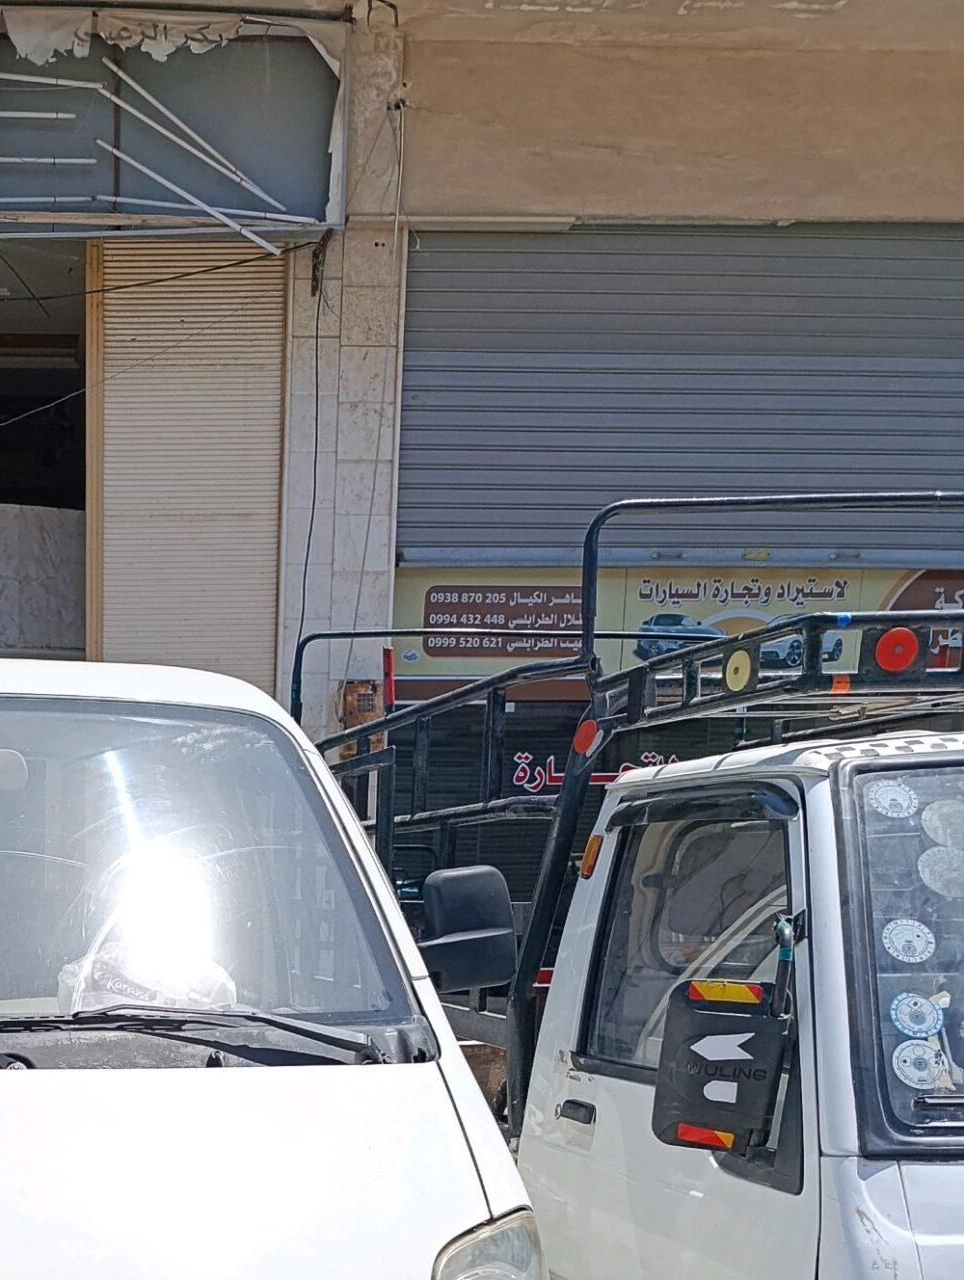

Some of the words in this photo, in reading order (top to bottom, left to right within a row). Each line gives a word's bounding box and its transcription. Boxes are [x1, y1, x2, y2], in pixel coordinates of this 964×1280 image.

[430, 592, 459, 604] 0938
[461, 592, 483, 604] 870
[485, 592, 506, 604] 205
[638, 578, 708, 606] السيارات
[711, 577, 772, 607] وتجارة
[776, 577, 849, 606] لاستيراد
[549, 592, 582, 606] اهر
[429, 613, 458, 625] 0994
[460, 613, 481, 625] 432
[484, 613, 505, 625] 448
[427, 637, 456, 648] 0999
[459, 637, 479, 648] 520
[482, 637, 503, 648] 621
[686, 1062, 768, 1080] WULING
